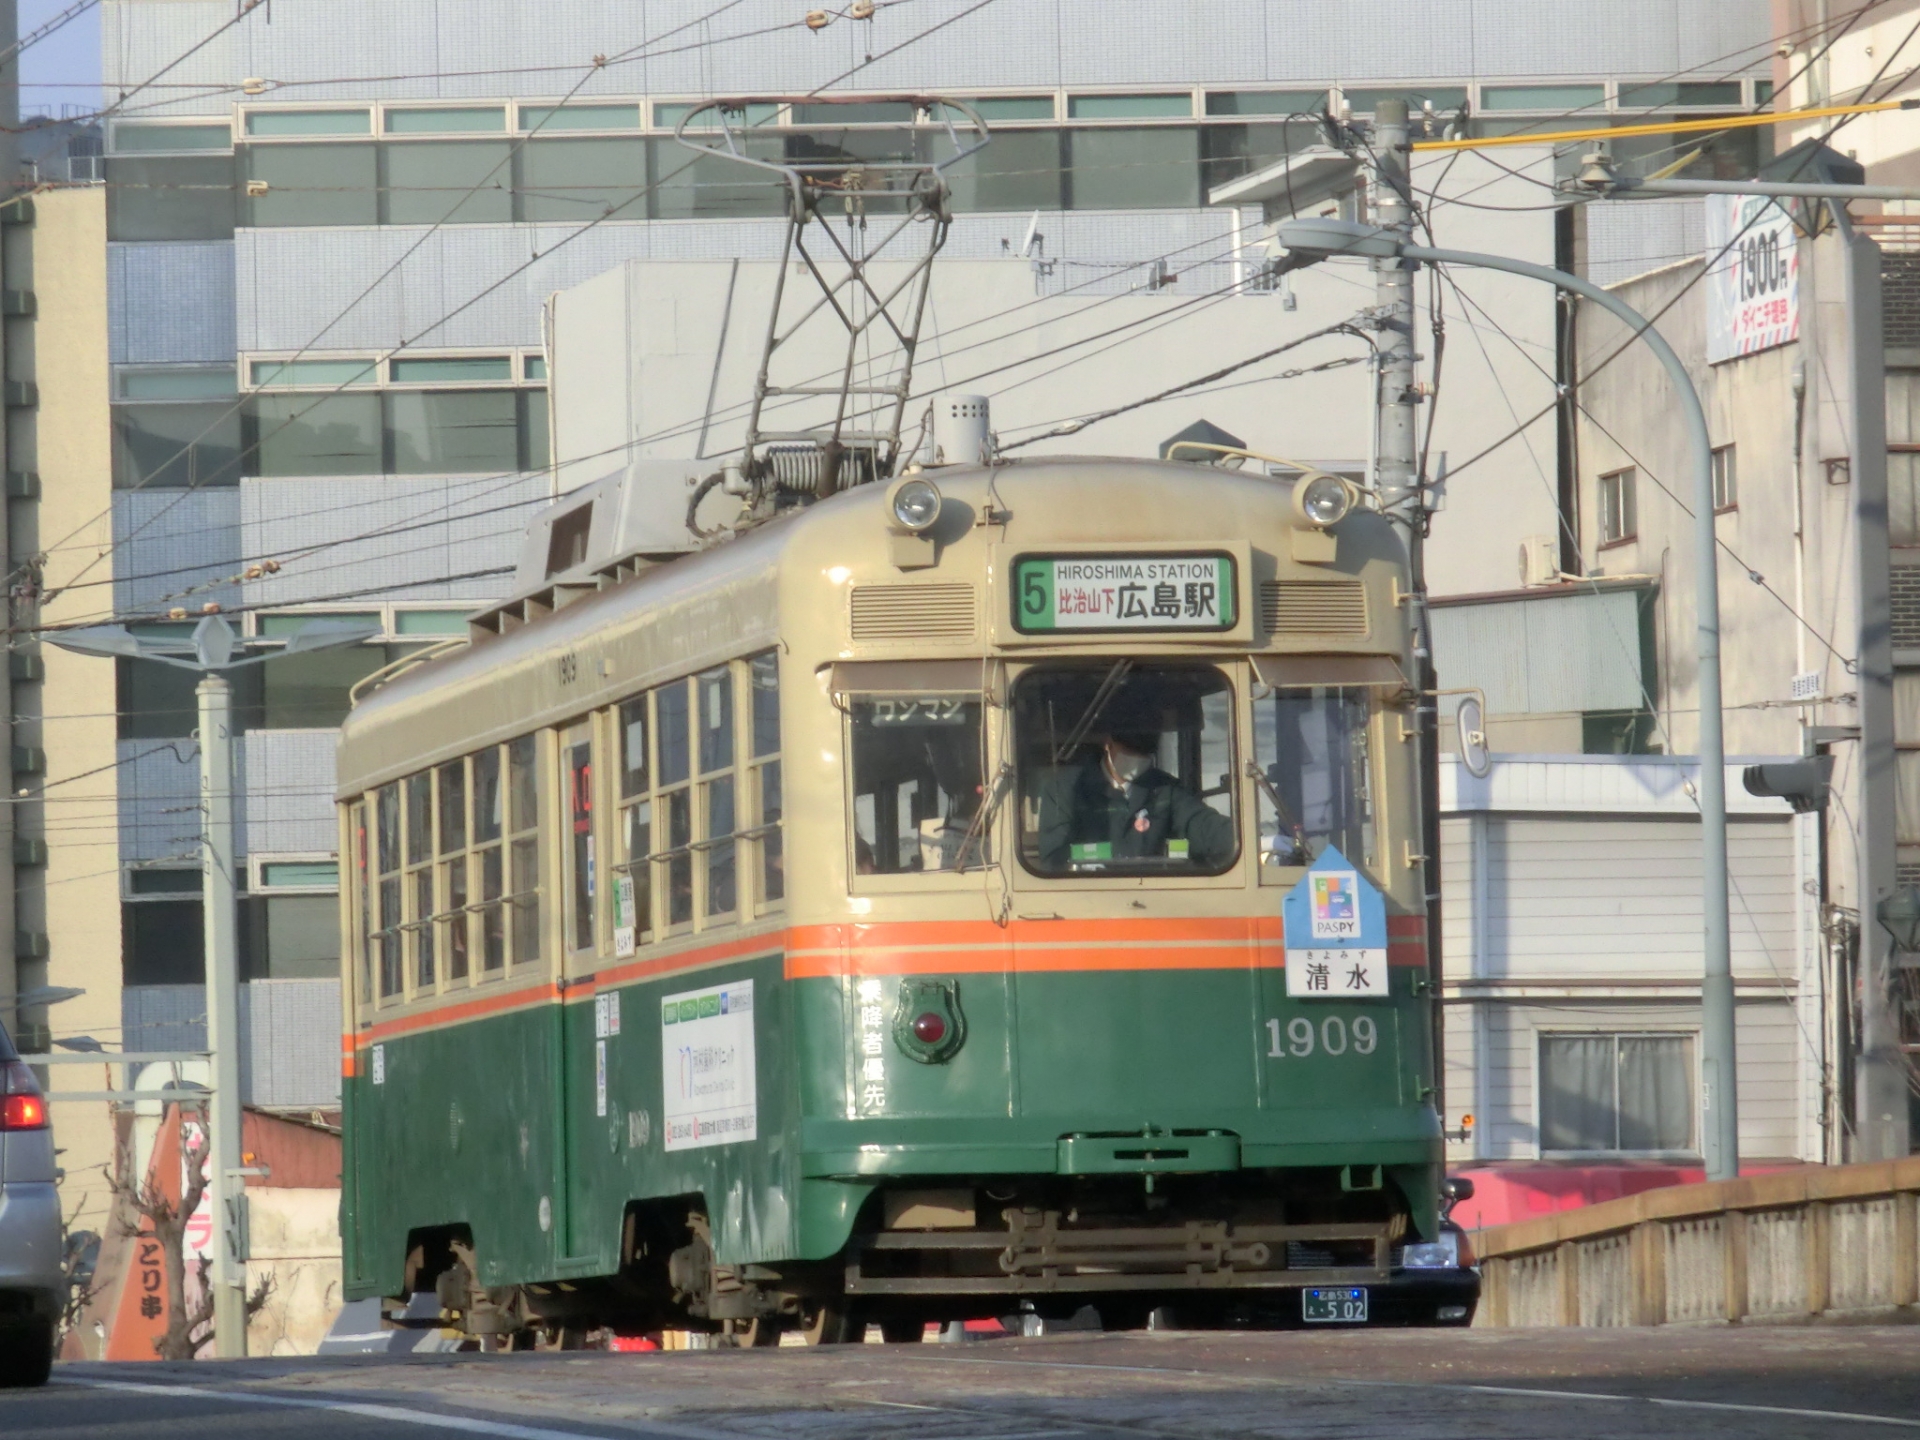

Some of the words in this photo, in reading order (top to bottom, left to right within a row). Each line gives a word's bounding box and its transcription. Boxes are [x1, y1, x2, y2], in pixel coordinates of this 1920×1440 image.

[1057, 564, 1143, 580] HIROSHIMA
[1147, 564, 1214, 579] STATION
[1024, 572, 1046, 615] 5
[1058, 587, 1115, 615] 比治山下
[1116, 581, 1216, 619] 広島駅
[875, 699, 963, 722] ワンマン
[1317, 921, 1355, 934] PASPY
[1306, 949, 1367, 961] きよみず
[1306, 962, 1371, 991] 清水
[1265, 1015, 1378, 1058] 1909
[139, 1244, 163, 1320] とり串
